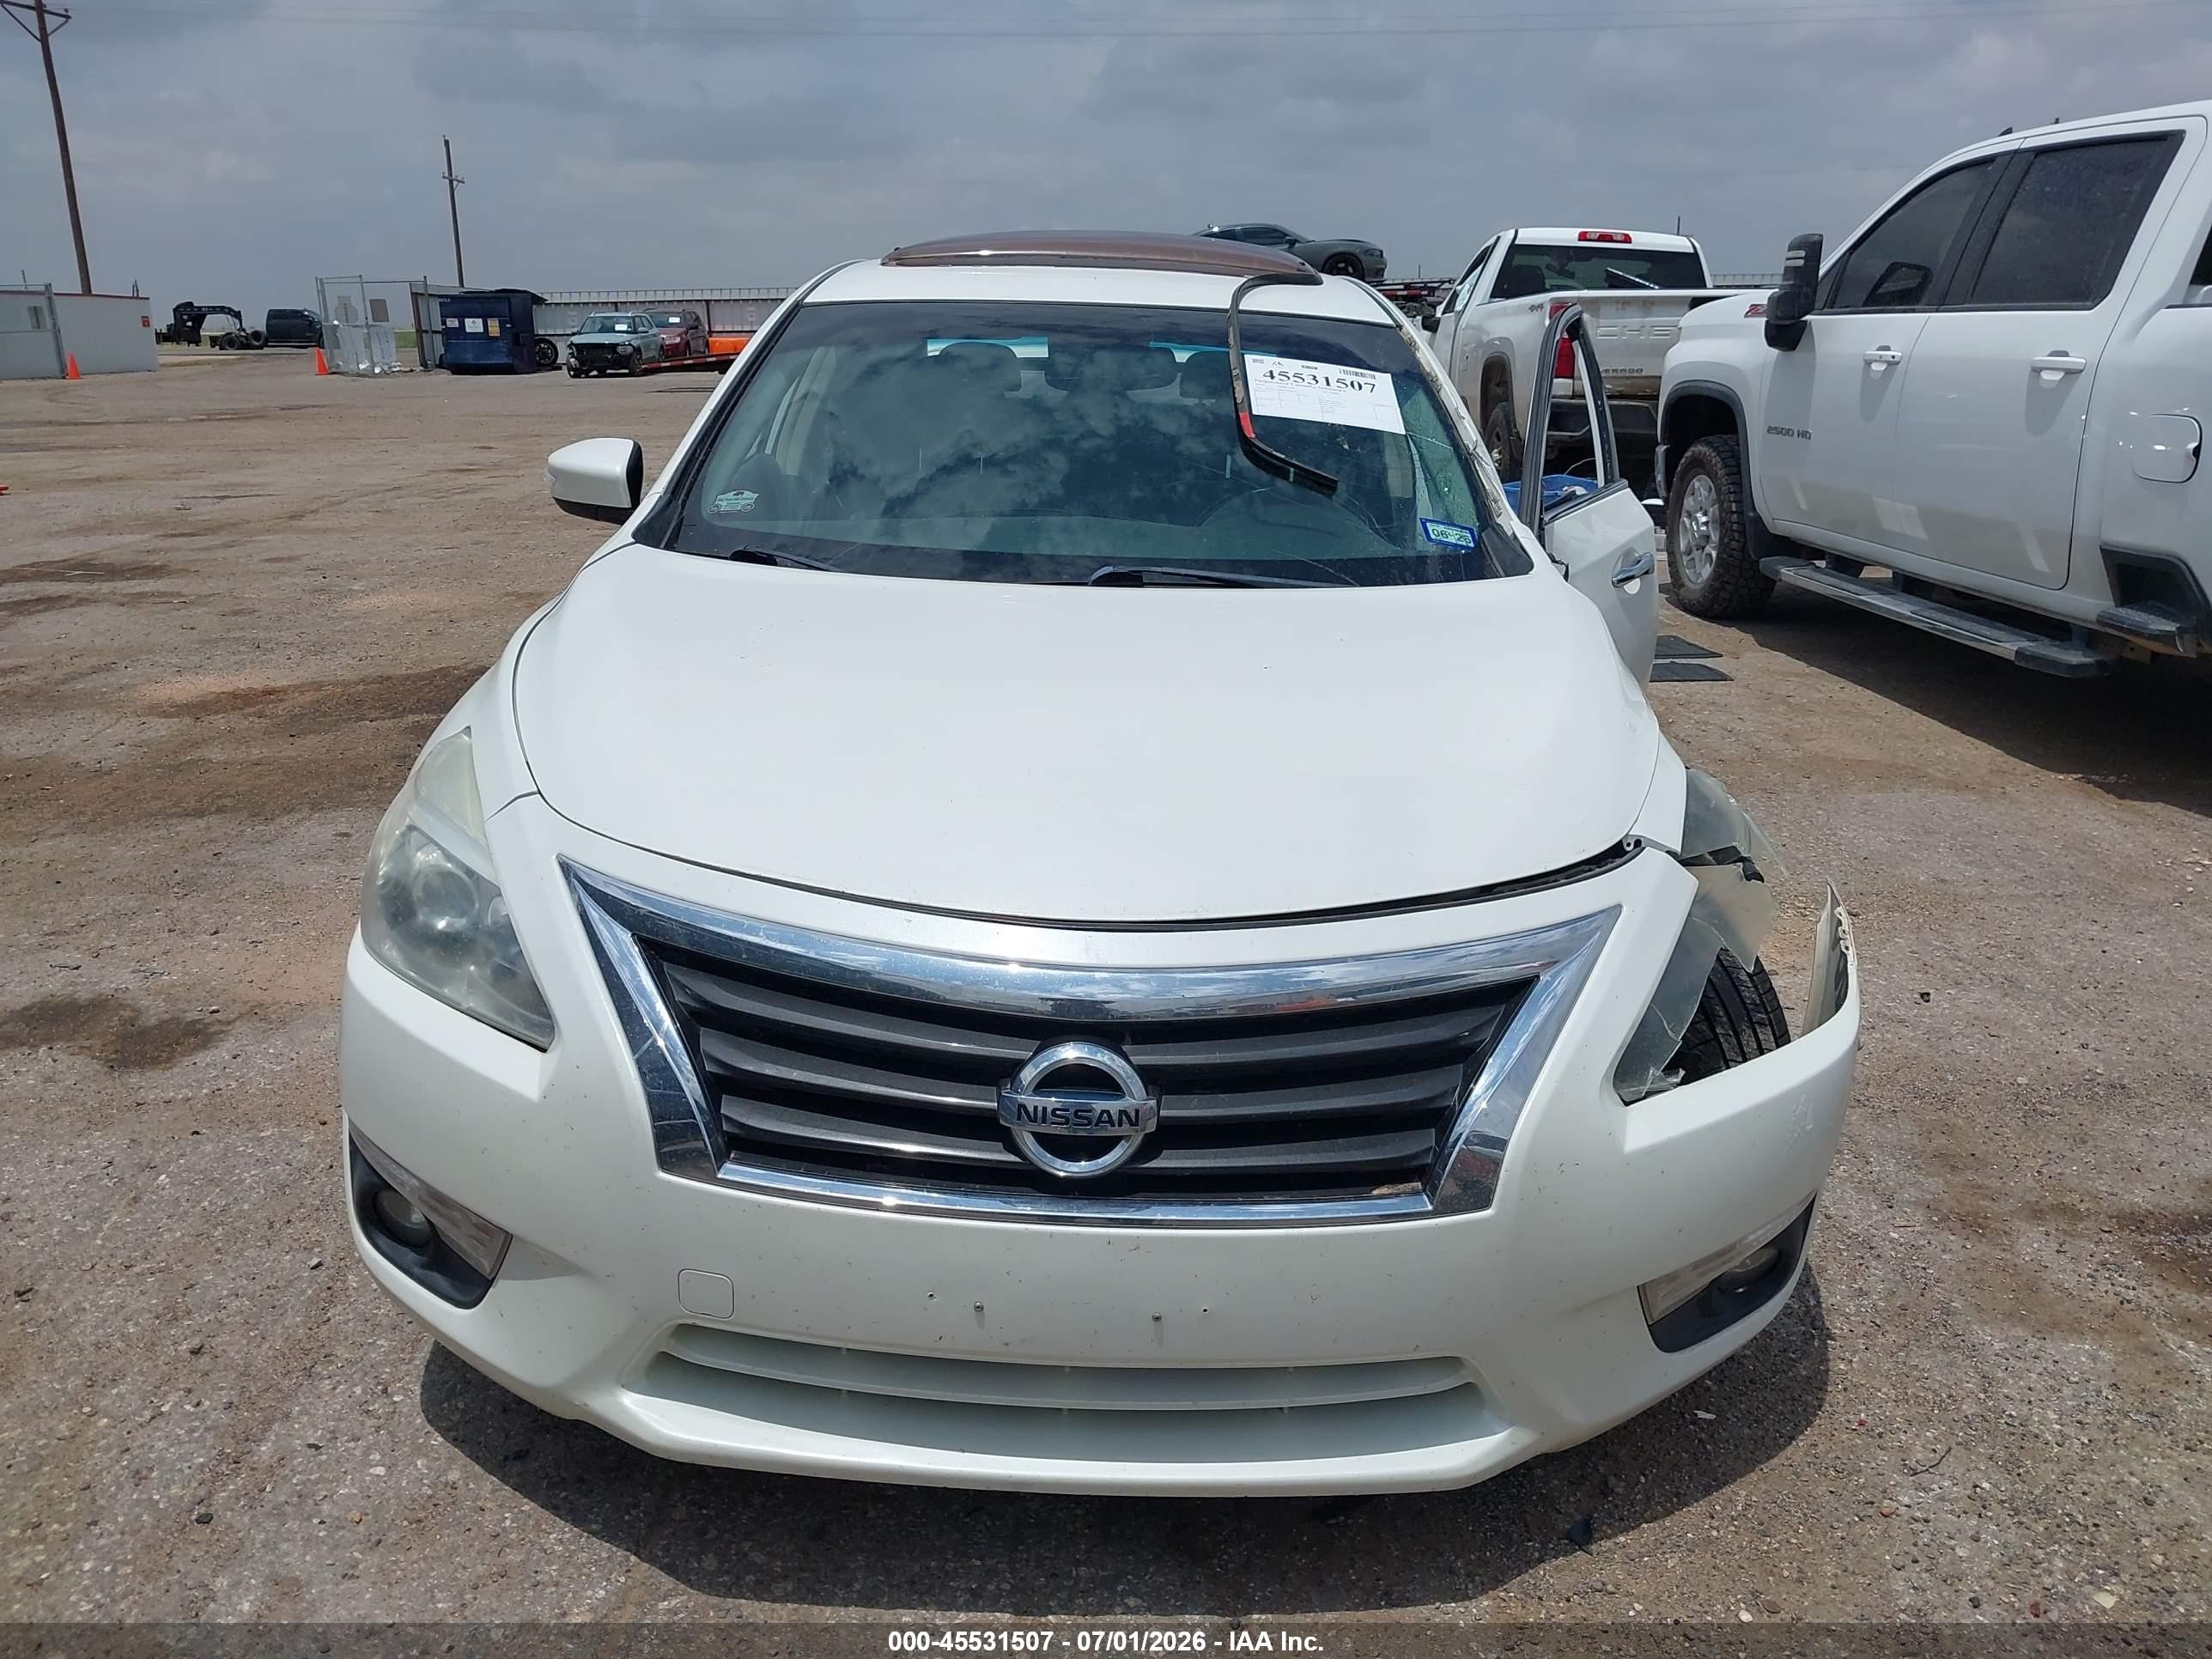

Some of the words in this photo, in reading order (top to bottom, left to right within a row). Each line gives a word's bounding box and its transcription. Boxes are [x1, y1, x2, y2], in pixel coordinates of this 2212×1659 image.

[1262, 369, 1376, 394] 45531507
[1766, 425, 1795, 437] 2500
[1796, 429, 1812, 440] HD
[1016, 1103, 1140, 1127] NISSAN
